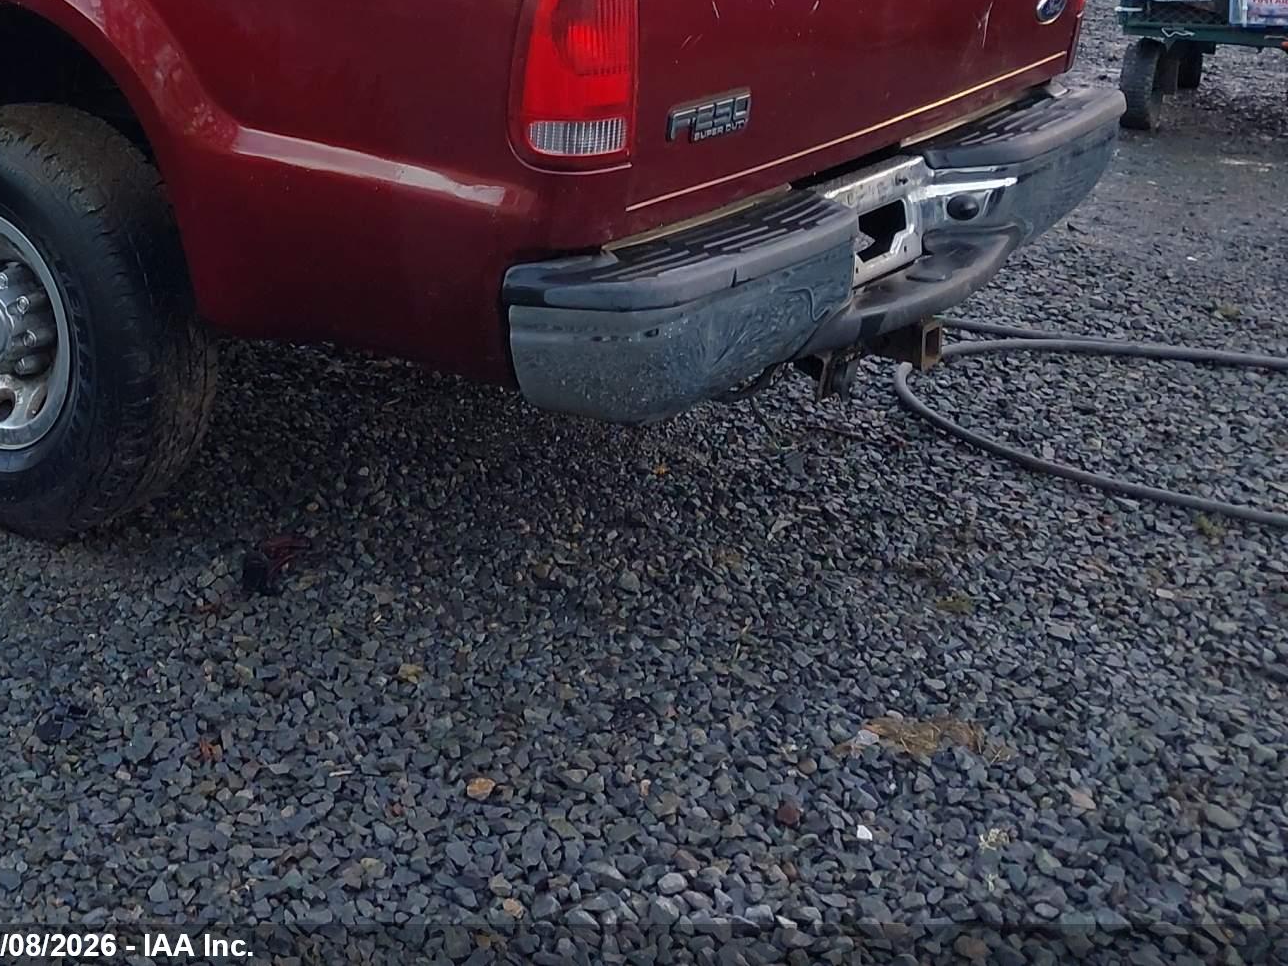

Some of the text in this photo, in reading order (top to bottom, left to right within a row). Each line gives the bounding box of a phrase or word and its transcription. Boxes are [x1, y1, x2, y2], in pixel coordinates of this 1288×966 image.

[669, 92, 752, 141] F250
[694, 118, 749, 141] SUPER DUTY
